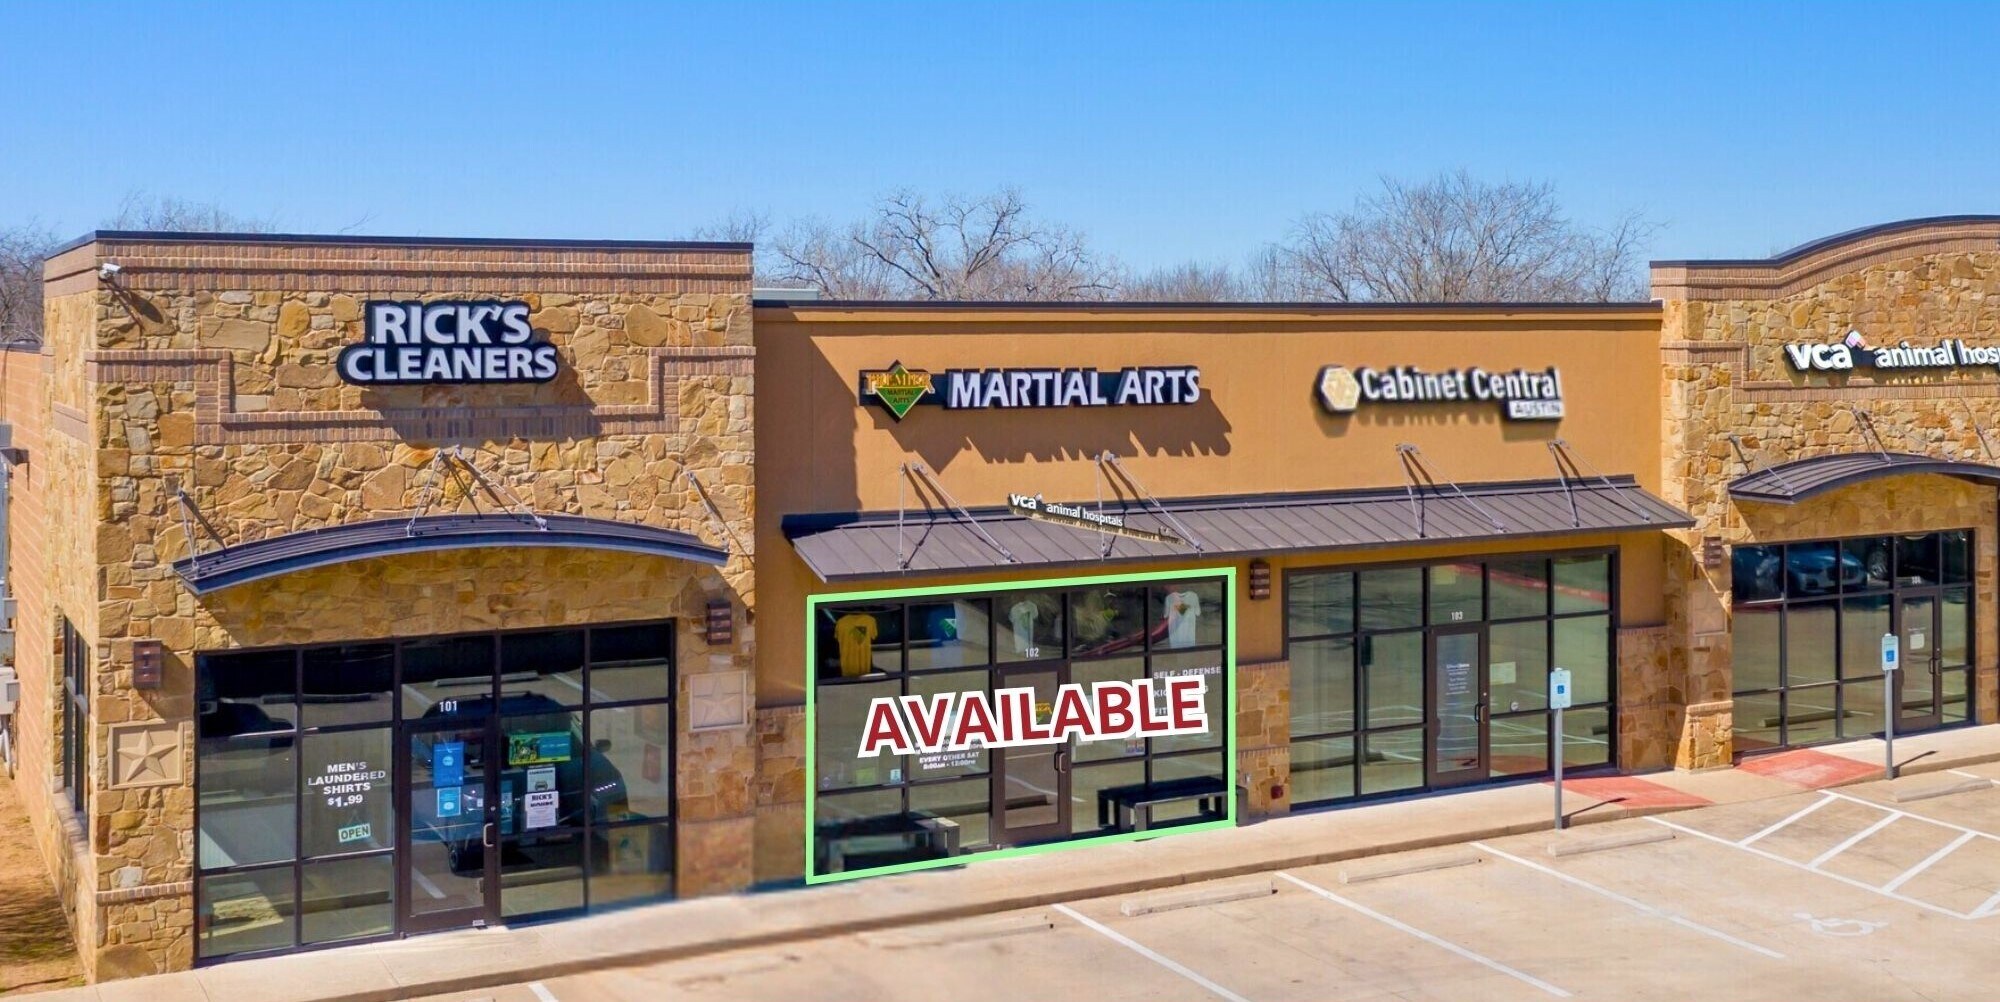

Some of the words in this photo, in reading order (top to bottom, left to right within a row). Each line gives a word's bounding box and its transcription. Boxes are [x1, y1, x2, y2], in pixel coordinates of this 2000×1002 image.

[373, 304, 532, 345] RICK'S
[1785, 343, 1853, 371] vca
[1874, 339, 1956, 369] animal
[345, 346, 559, 381] CLEANERS
[949, 370, 1107, 408] MARTIAL
[1117, 368, 1201, 405] ARTS
[1360, 367, 1470, 400] Cabinet
[1472, 368, 1562, 400] Central
[1514, 403, 1561, 415] AUSTIN
[1010, 494, 1037, 510] vca
[1045, 502, 1082, 519] animal
[1082, 507, 1124, 527] hospitals
[1451, 611, 1463, 620] 103
[1025, 647, 1040, 658] 102
[1153, 670, 1176, 679] SELF
[1182, 666, 1222, 676] DEFENSE
[439, 700, 458, 712] 101
[920, 754, 941, 763] EVERY
[942, 753, 966, 761] OTHER
[967, 751, 980, 759] SAT
[327, 761, 368, 773] MEN'S
[307, 770, 386, 786] LAUNDERED
[323, 782, 372, 795] SHIRTS
[327, 794, 364, 808] $1.99
[340, 825, 370, 840] OPEN
